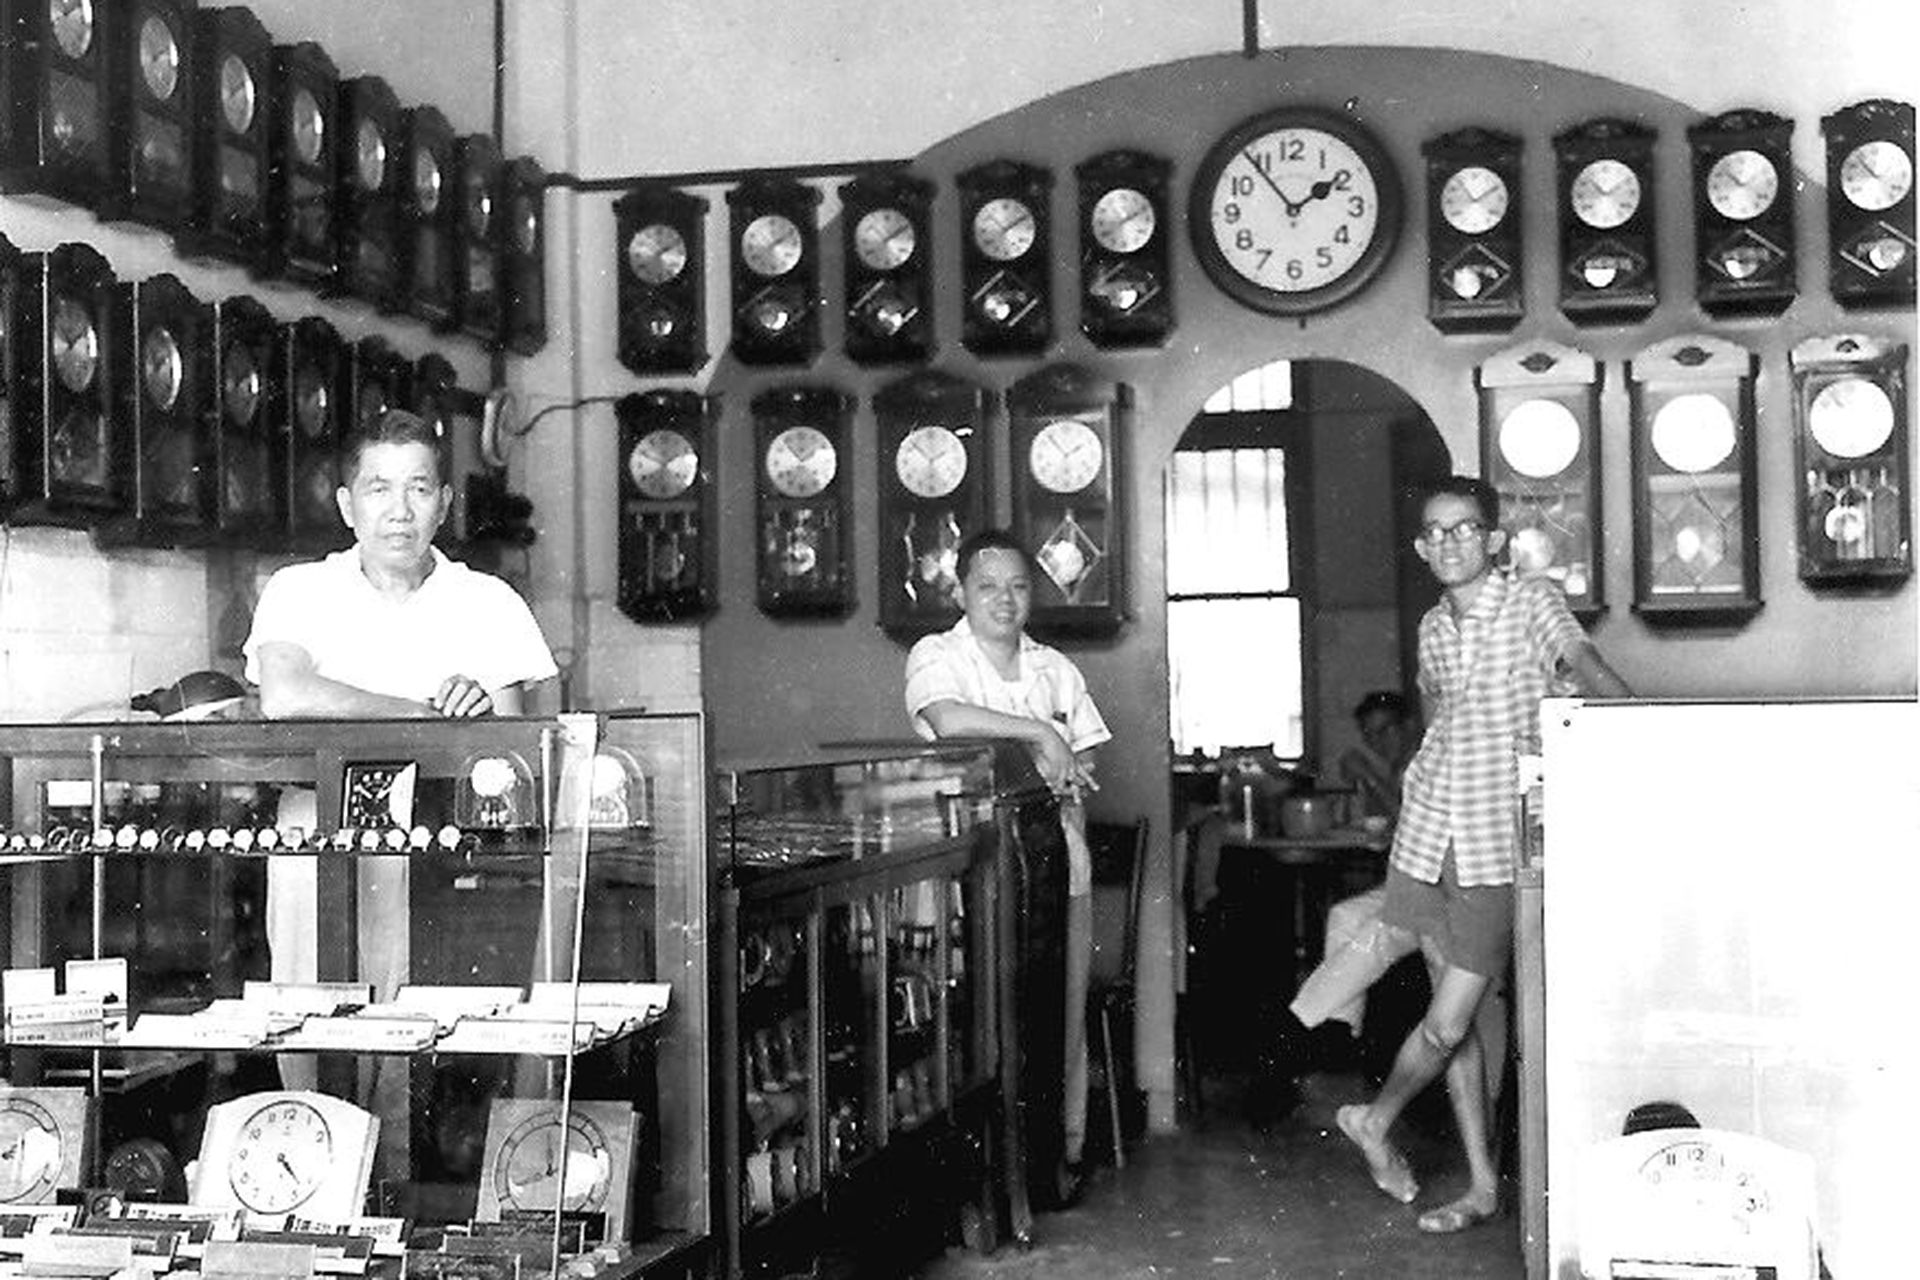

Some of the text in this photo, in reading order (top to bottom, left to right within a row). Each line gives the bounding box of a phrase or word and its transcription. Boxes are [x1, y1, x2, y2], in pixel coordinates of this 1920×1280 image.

[1279, 139, 1304, 161] 12
[1319, 150, 1326, 169] 1
[1232, 176, 1254, 197] 10
[1335, 169, 1351, 191] 2
[1224, 203, 1240, 224] 9
[1348, 196, 1364, 217] 3
[1236, 229, 1253, 250] 8
[1333, 225, 1349, 244] 4
[1256, 249, 1273, 270] 7
[1316, 247, 1332, 268] 5
[1286, 260, 1303, 280] 6
